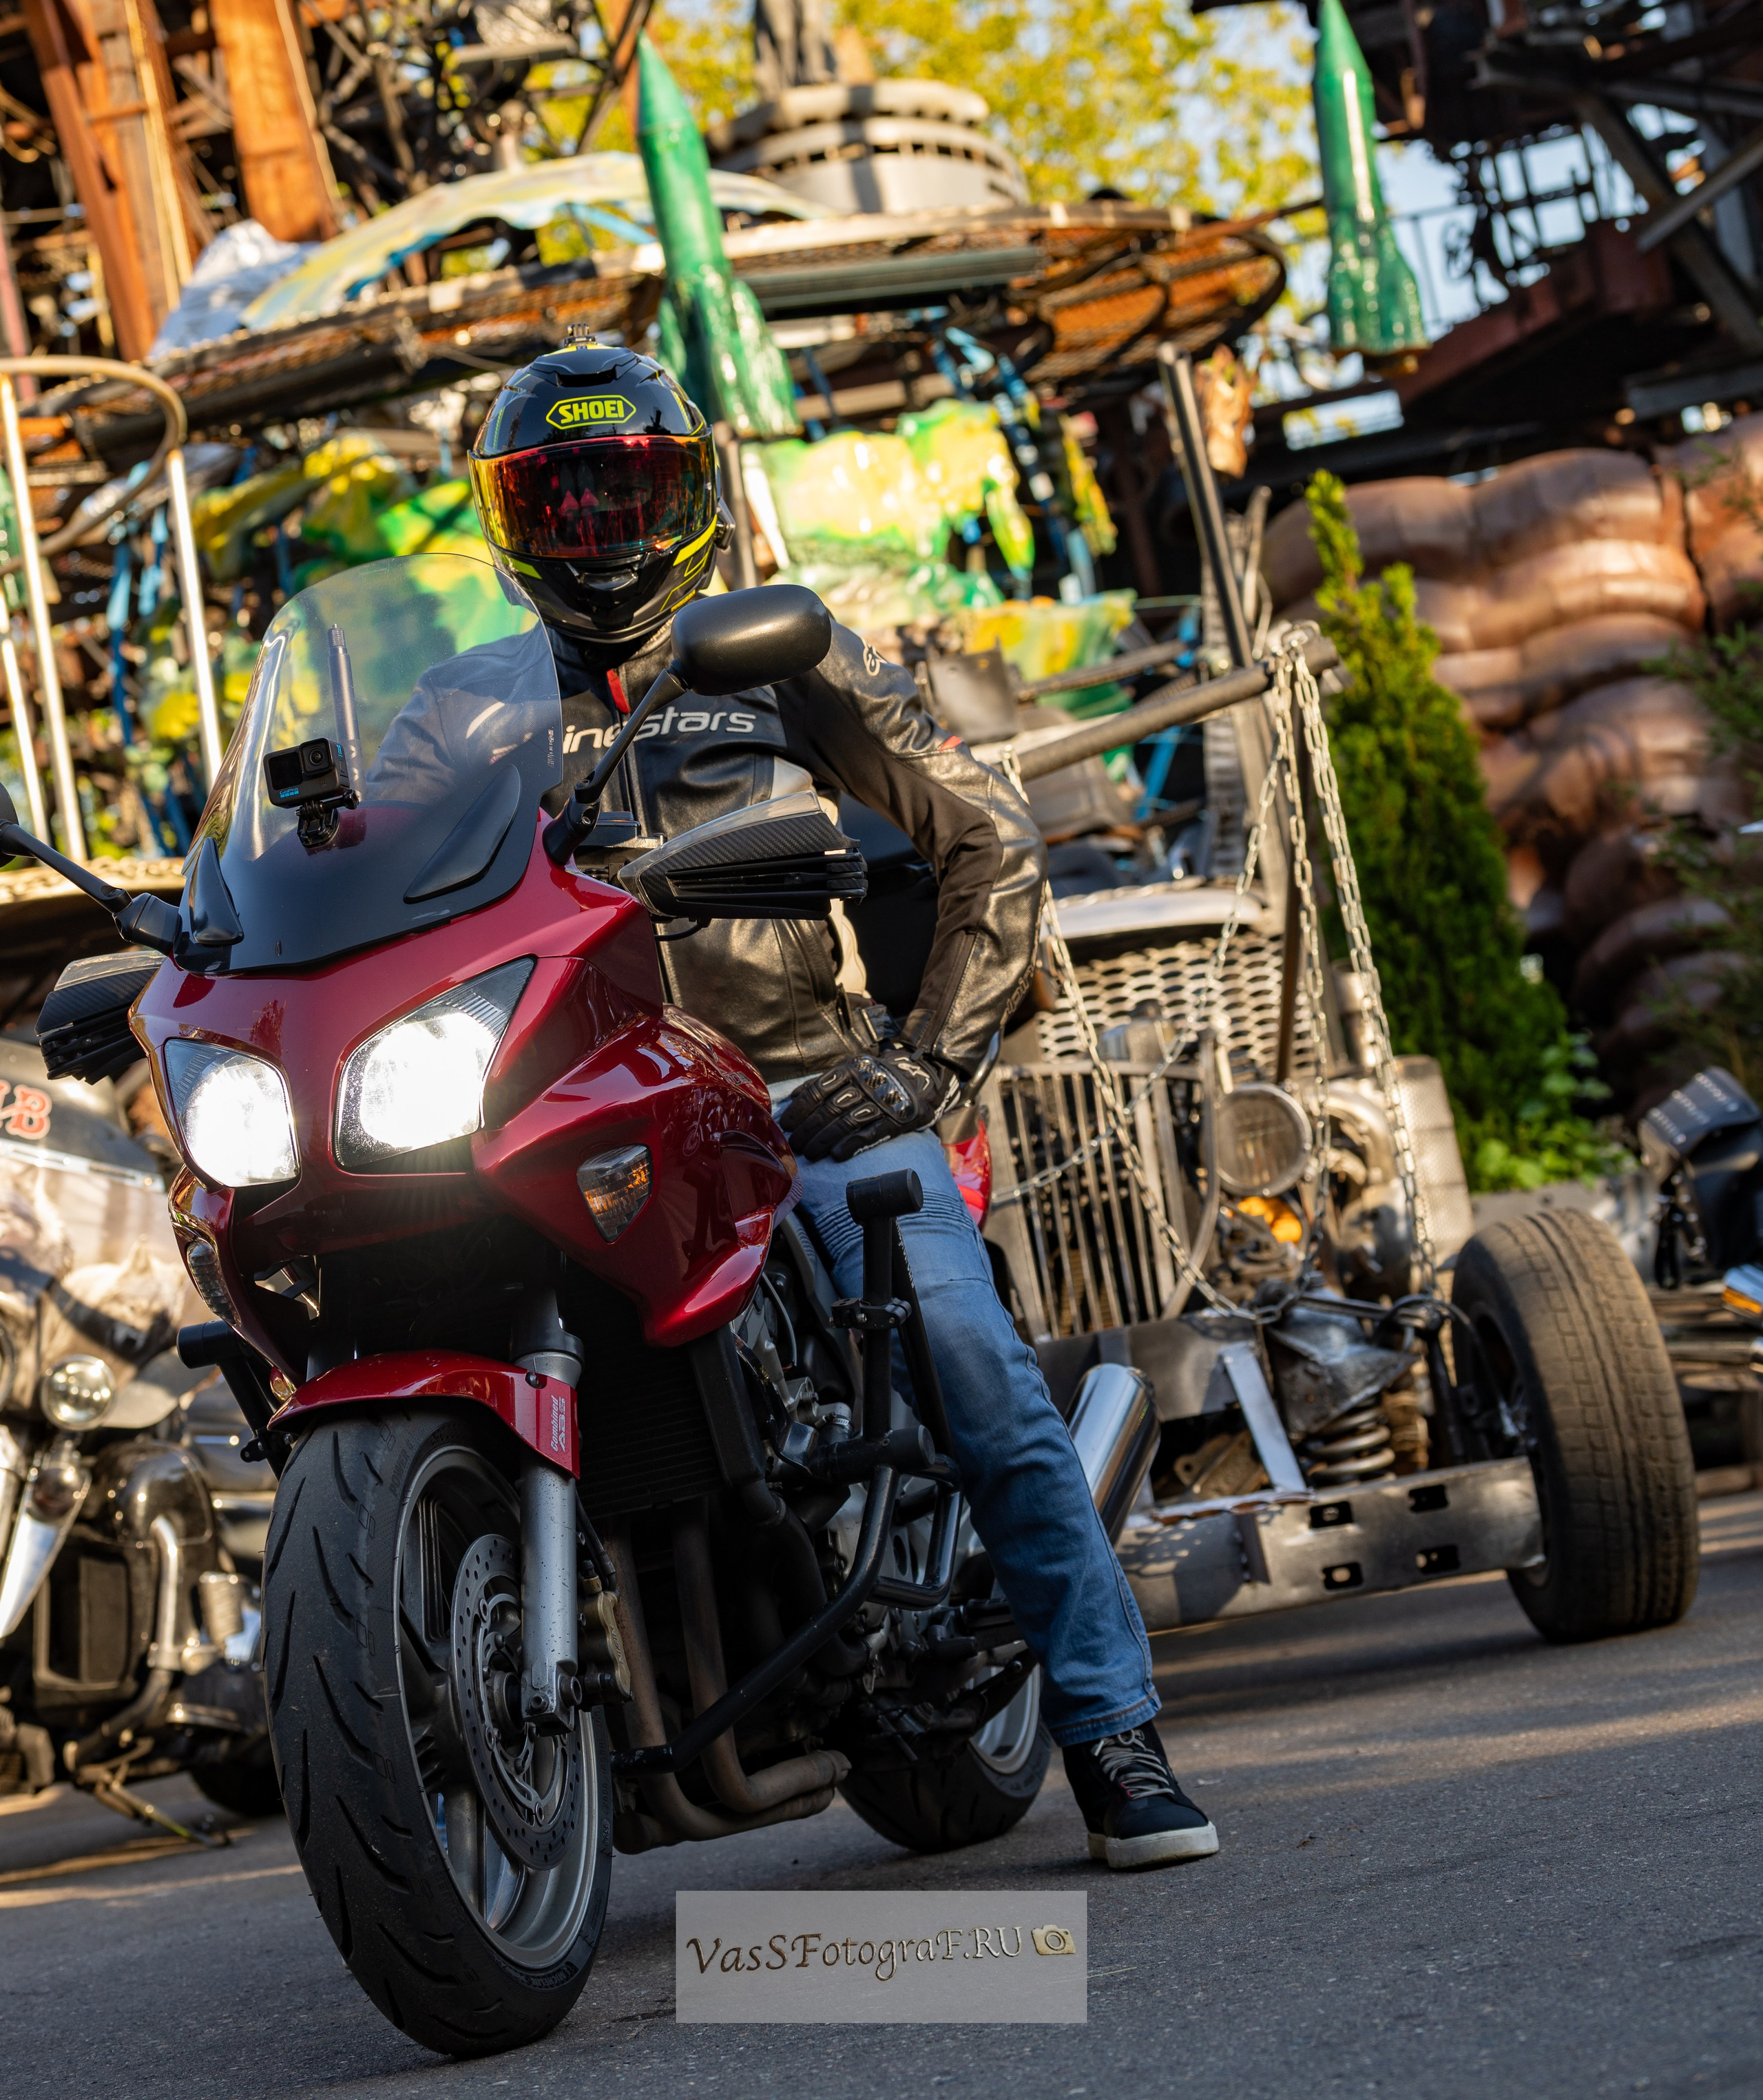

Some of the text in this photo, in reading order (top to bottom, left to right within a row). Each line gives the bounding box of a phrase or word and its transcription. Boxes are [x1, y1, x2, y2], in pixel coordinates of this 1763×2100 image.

[558, 399, 625, 424] SHOEI
[279, 787, 299, 795] GoPro
[550, 1394, 559, 1453] Combined
[388, 1448, 410, 1498] POWER
[530, 1969, 566, 1987] MICHELIN
